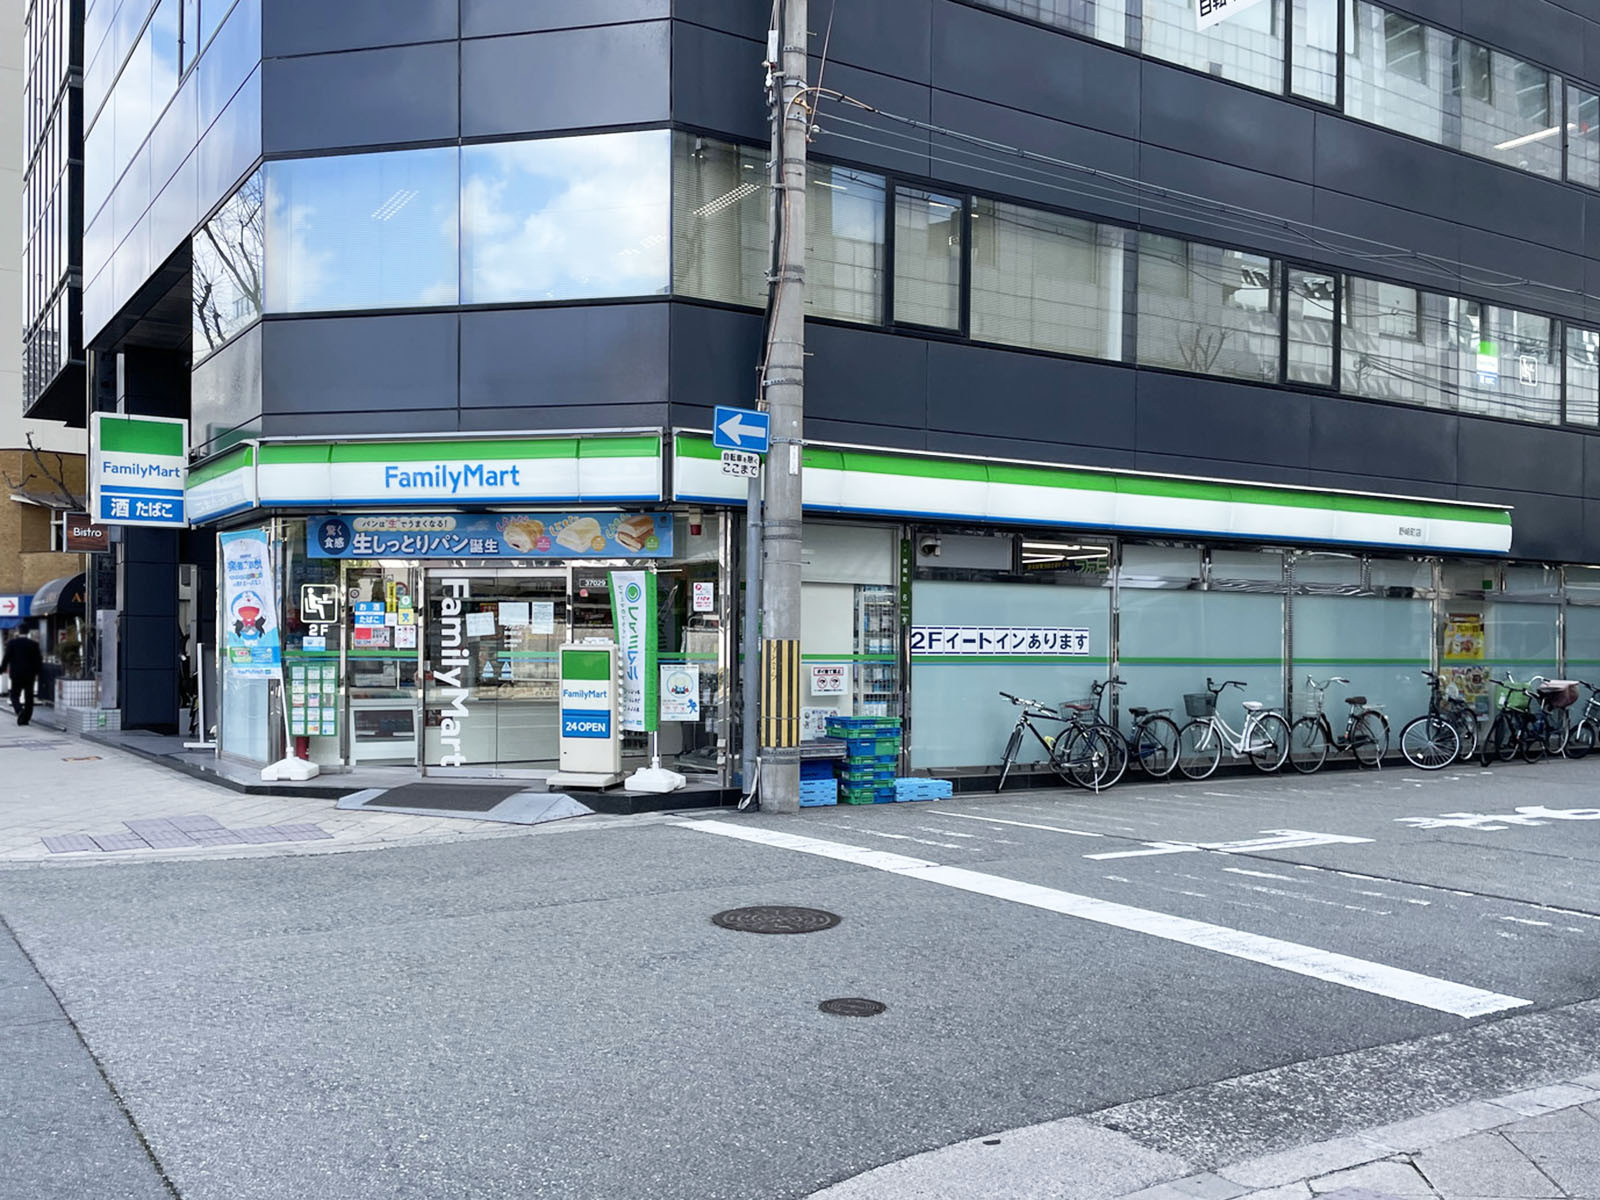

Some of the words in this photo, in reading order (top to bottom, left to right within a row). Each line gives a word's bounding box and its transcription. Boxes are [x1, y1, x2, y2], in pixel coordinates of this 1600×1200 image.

[103, 461, 180, 479] FamilyMart
[723, 462, 757, 476] ここまで
[385, 464, 520, 493] FamilyMart
[111, 498, 129, 517] 酒
[136, 502, 173, 518] たばこ
[73, 527, 102, 538] Bistro
[324, 537, 344, 549] 食感
[309, 625, 328, 635] 2F
[911, 631, 1087, 650] 2Fイートインあります
[433, 579, 469, 767] FamilyMart
[563, 688, 607, 699] FamilyMart
